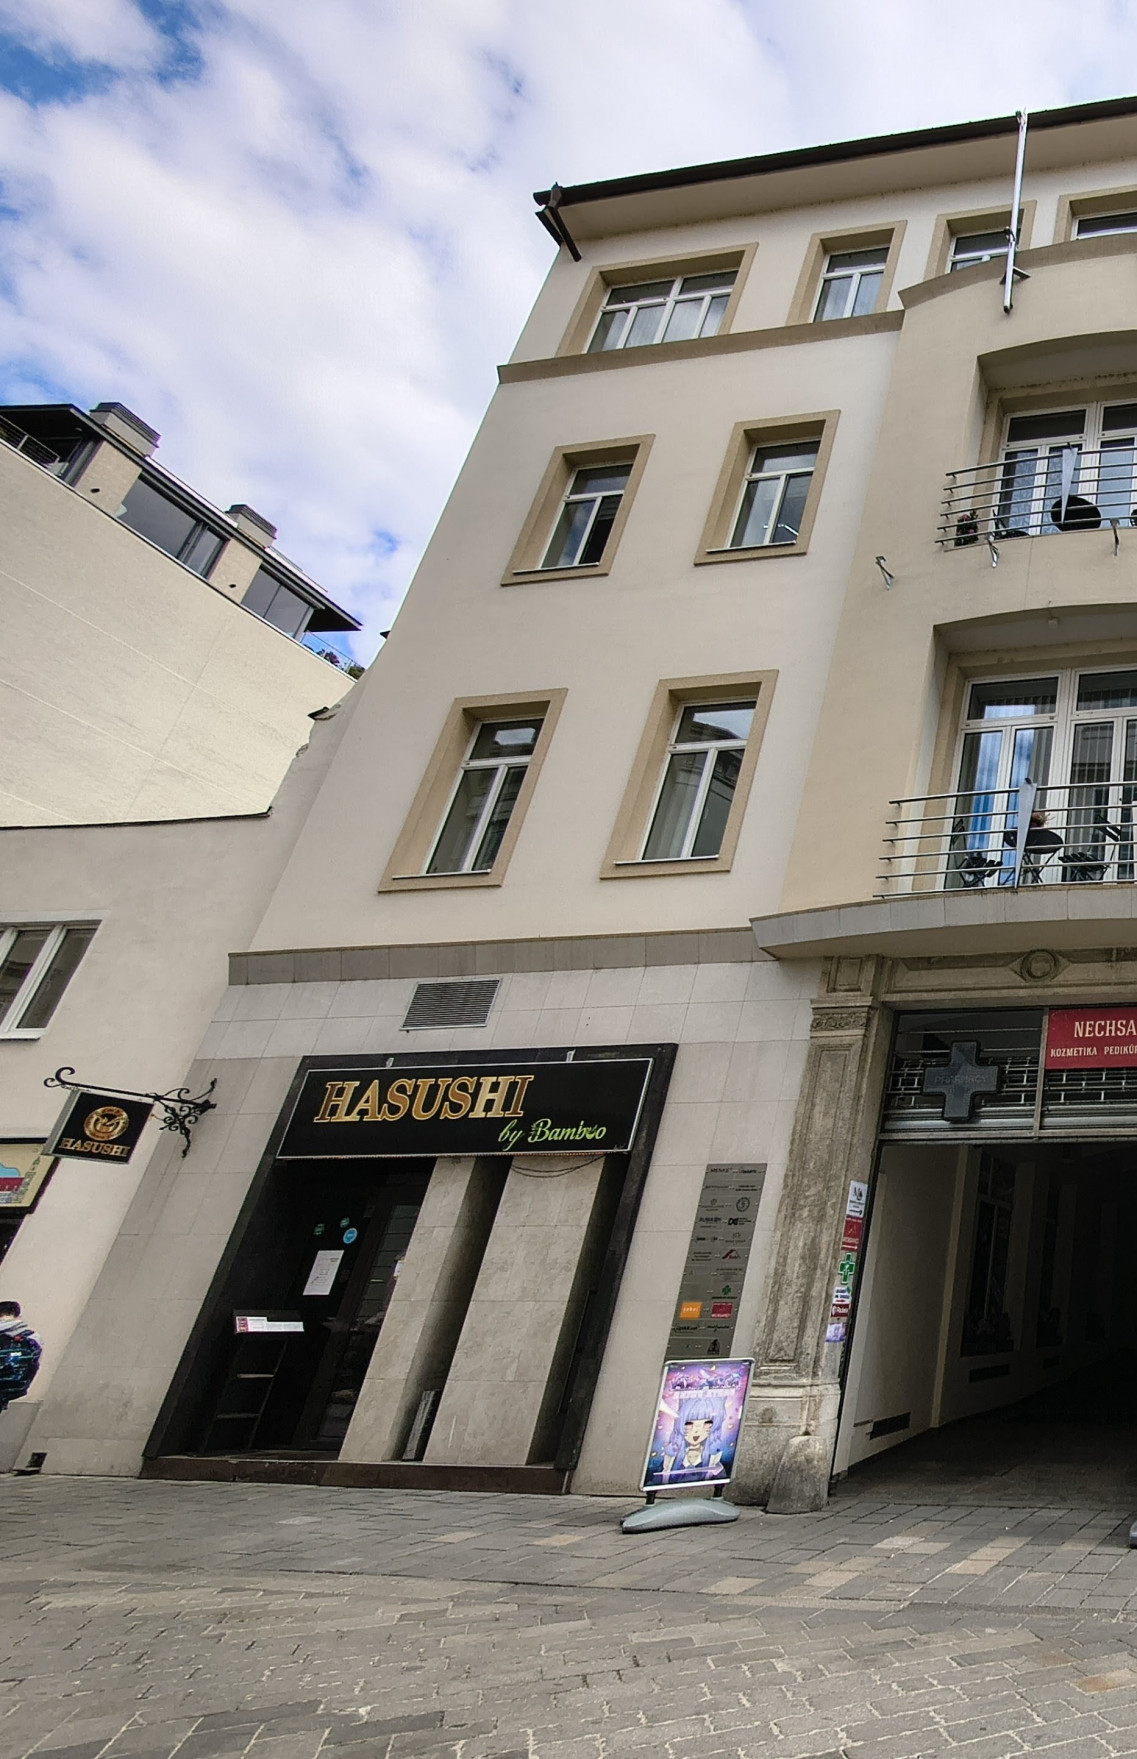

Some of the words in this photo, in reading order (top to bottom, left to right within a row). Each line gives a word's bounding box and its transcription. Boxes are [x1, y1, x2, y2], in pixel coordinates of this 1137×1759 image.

[1050, 1047, 1098, 1057] KOZMETIKA
[313, 1075, 534, 1123] HASUSHI
[59, 1137, 131, 1157] HASUSHI
[498, 1119, 524, 1151] by
[528, 1118, 607, 1142] Bamboo
